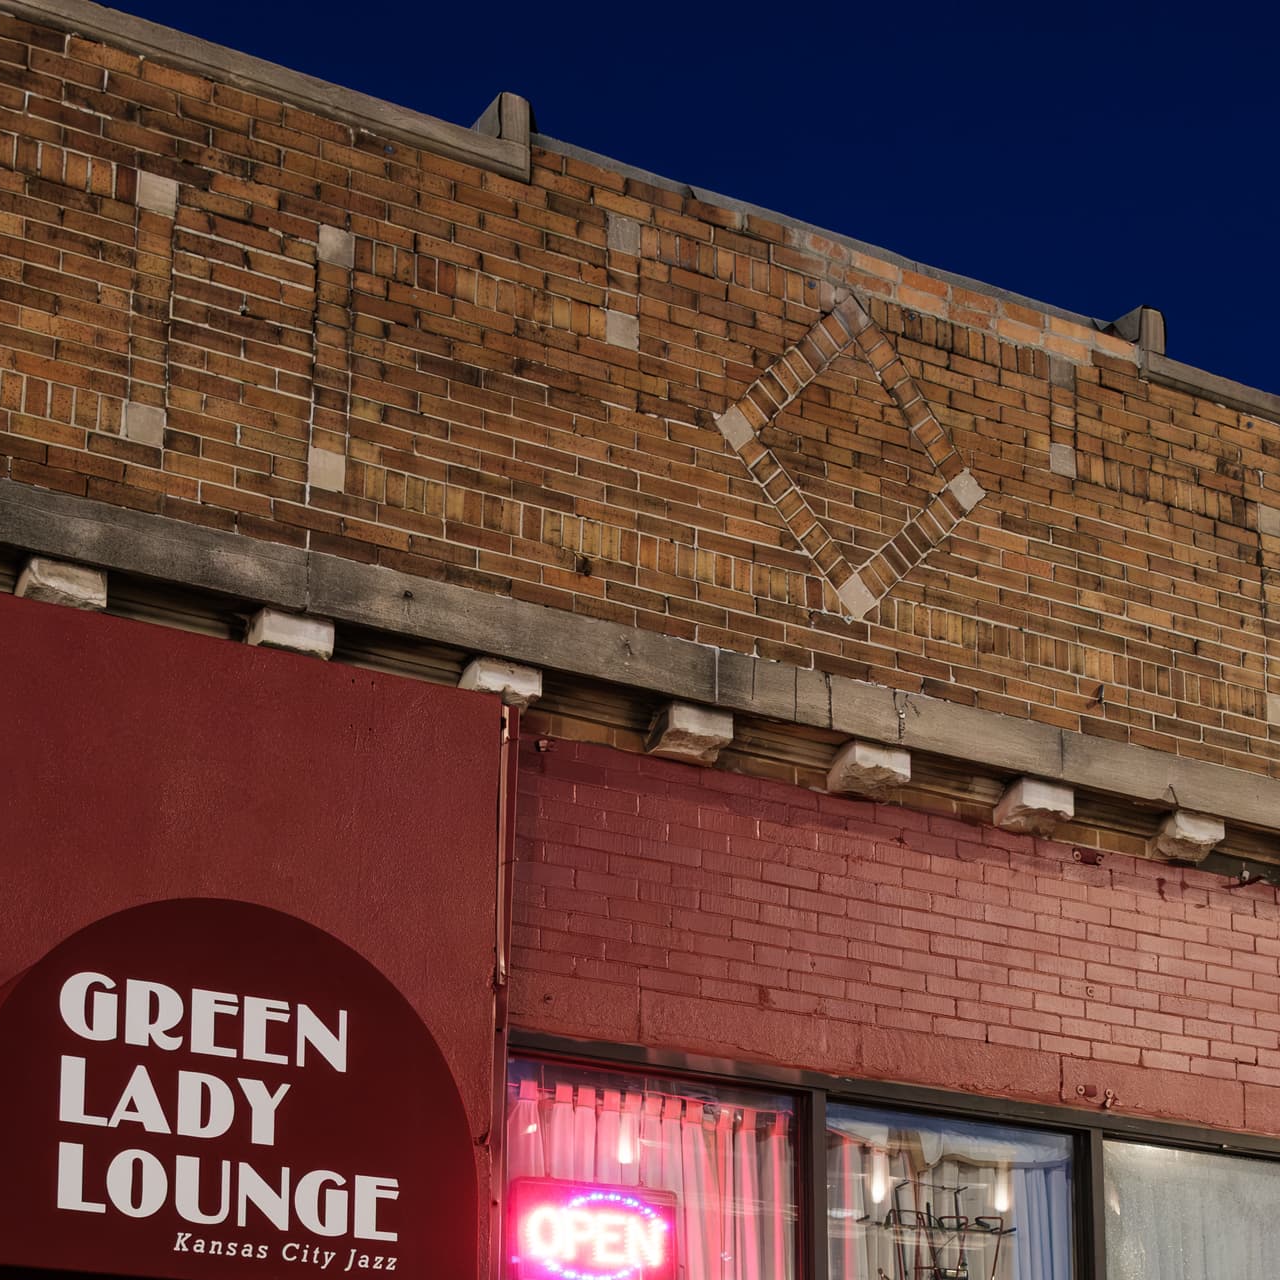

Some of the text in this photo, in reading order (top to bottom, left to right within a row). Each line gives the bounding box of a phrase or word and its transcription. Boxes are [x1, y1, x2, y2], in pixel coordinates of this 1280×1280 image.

[58, 971, 348, 1073] GREEN
[58, 1055, 291, 1146] LADY
[56, 1141, 400, 1242] LOUNGE
[526, 1205, 665, 1269] OPEN
[173, 1232, 398, 1272] Kansas City Jazz
